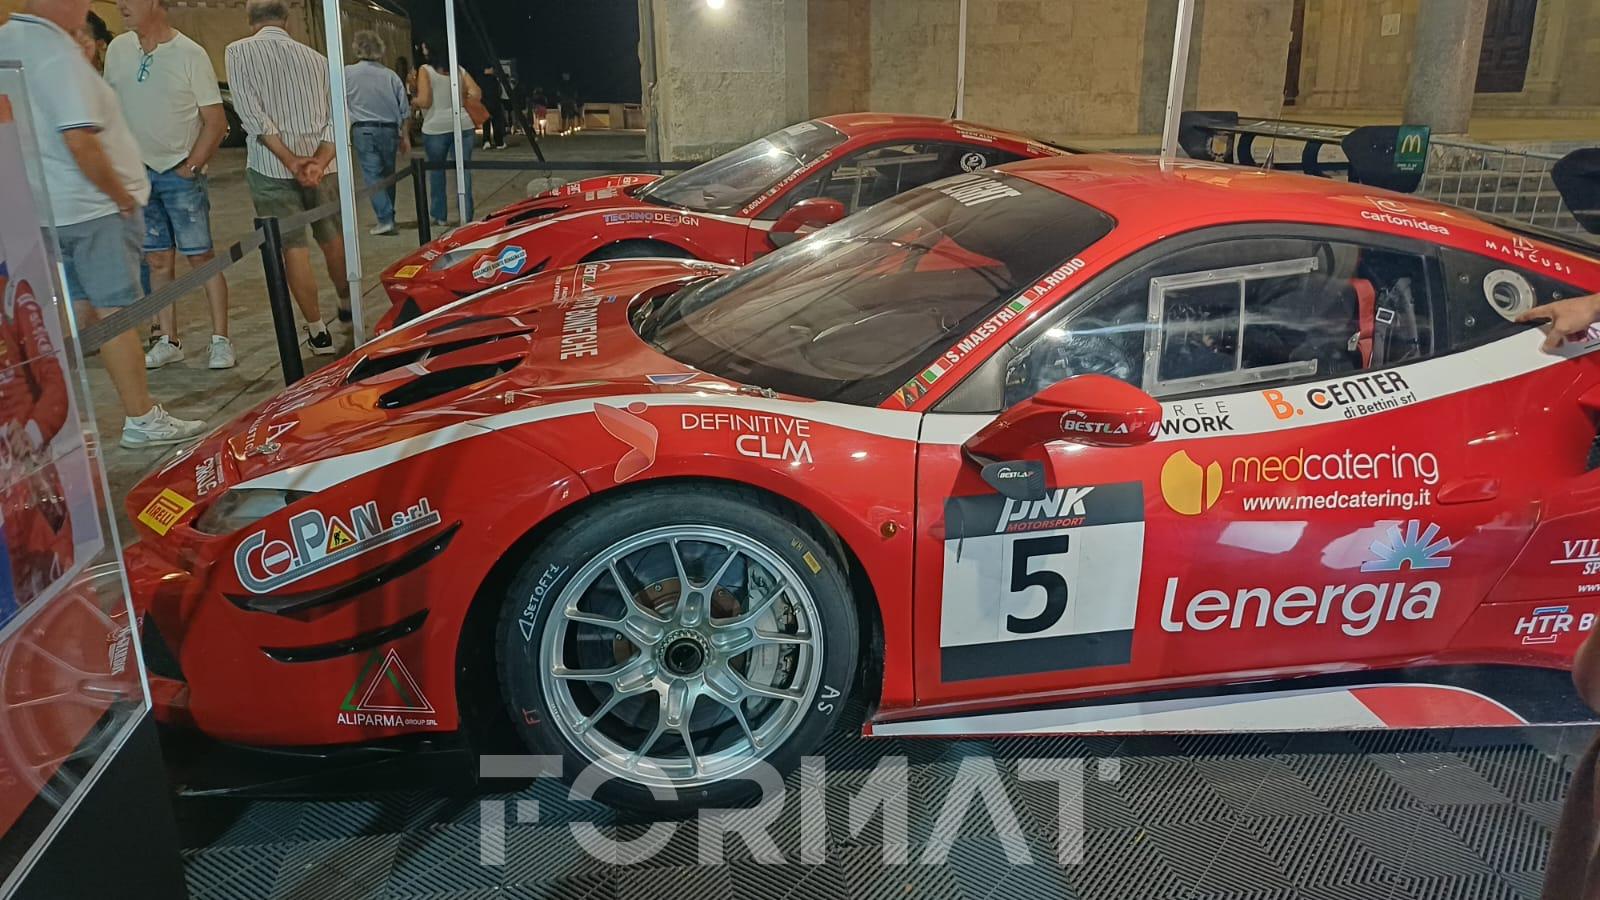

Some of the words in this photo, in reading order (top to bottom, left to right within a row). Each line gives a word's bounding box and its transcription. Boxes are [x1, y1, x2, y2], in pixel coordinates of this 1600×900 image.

[1360, 209, 1450, 236] cartonidea
[1485, 239, 1571, 275] MANCUSI
[946, 307, 1016, 364] S.MAESTRI
[1033, 257, 1086, 297] A.RODIO
[1306, 370, 1409, 410] CENTER
[1344, 407, 1357, 419] di
[1358, 397, 1399, 416] Bettini
[1400, 391, 1417, 405] srl
[681, 413, 811, 438] DEFINITIVE
[735, 434, 813, 464] CLM
[1230, 445, 1440, 485] medcatering
[147, 496, 185, 527] PIRELLI
[1242, 488, 1432, 512] www.medcatering.it
[1006, 516, 1086, 532] MOTORSPORT
[1582, 562, 1600, 575] SP
[1006, 534, 1070, 635] 5
[1514, 614, 1574, 636] HTR
[1578, 612, 1599, 632] B
[337, 712, 405, 727] ALIPARMA
